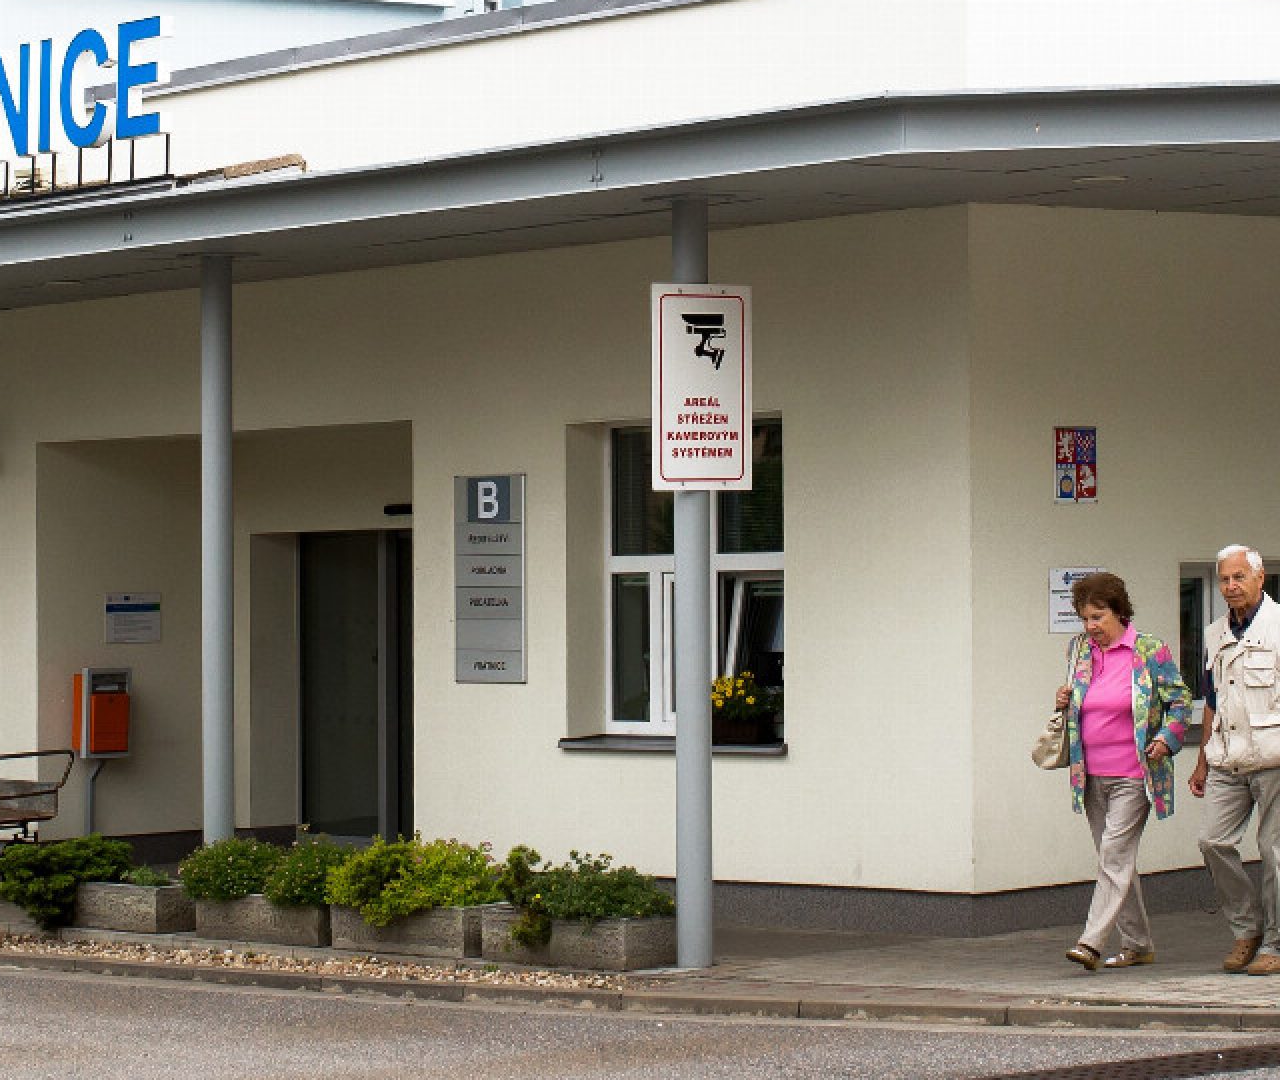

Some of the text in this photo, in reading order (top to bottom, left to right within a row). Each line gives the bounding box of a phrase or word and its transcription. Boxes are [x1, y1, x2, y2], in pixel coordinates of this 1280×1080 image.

[683, 396, 721, 407] AREÁL
[677, 411, 729, 424] STŘEŽEN
[667, 429, 739, 441] KAMEROVÝM
[477, 481, 500, 519] B
